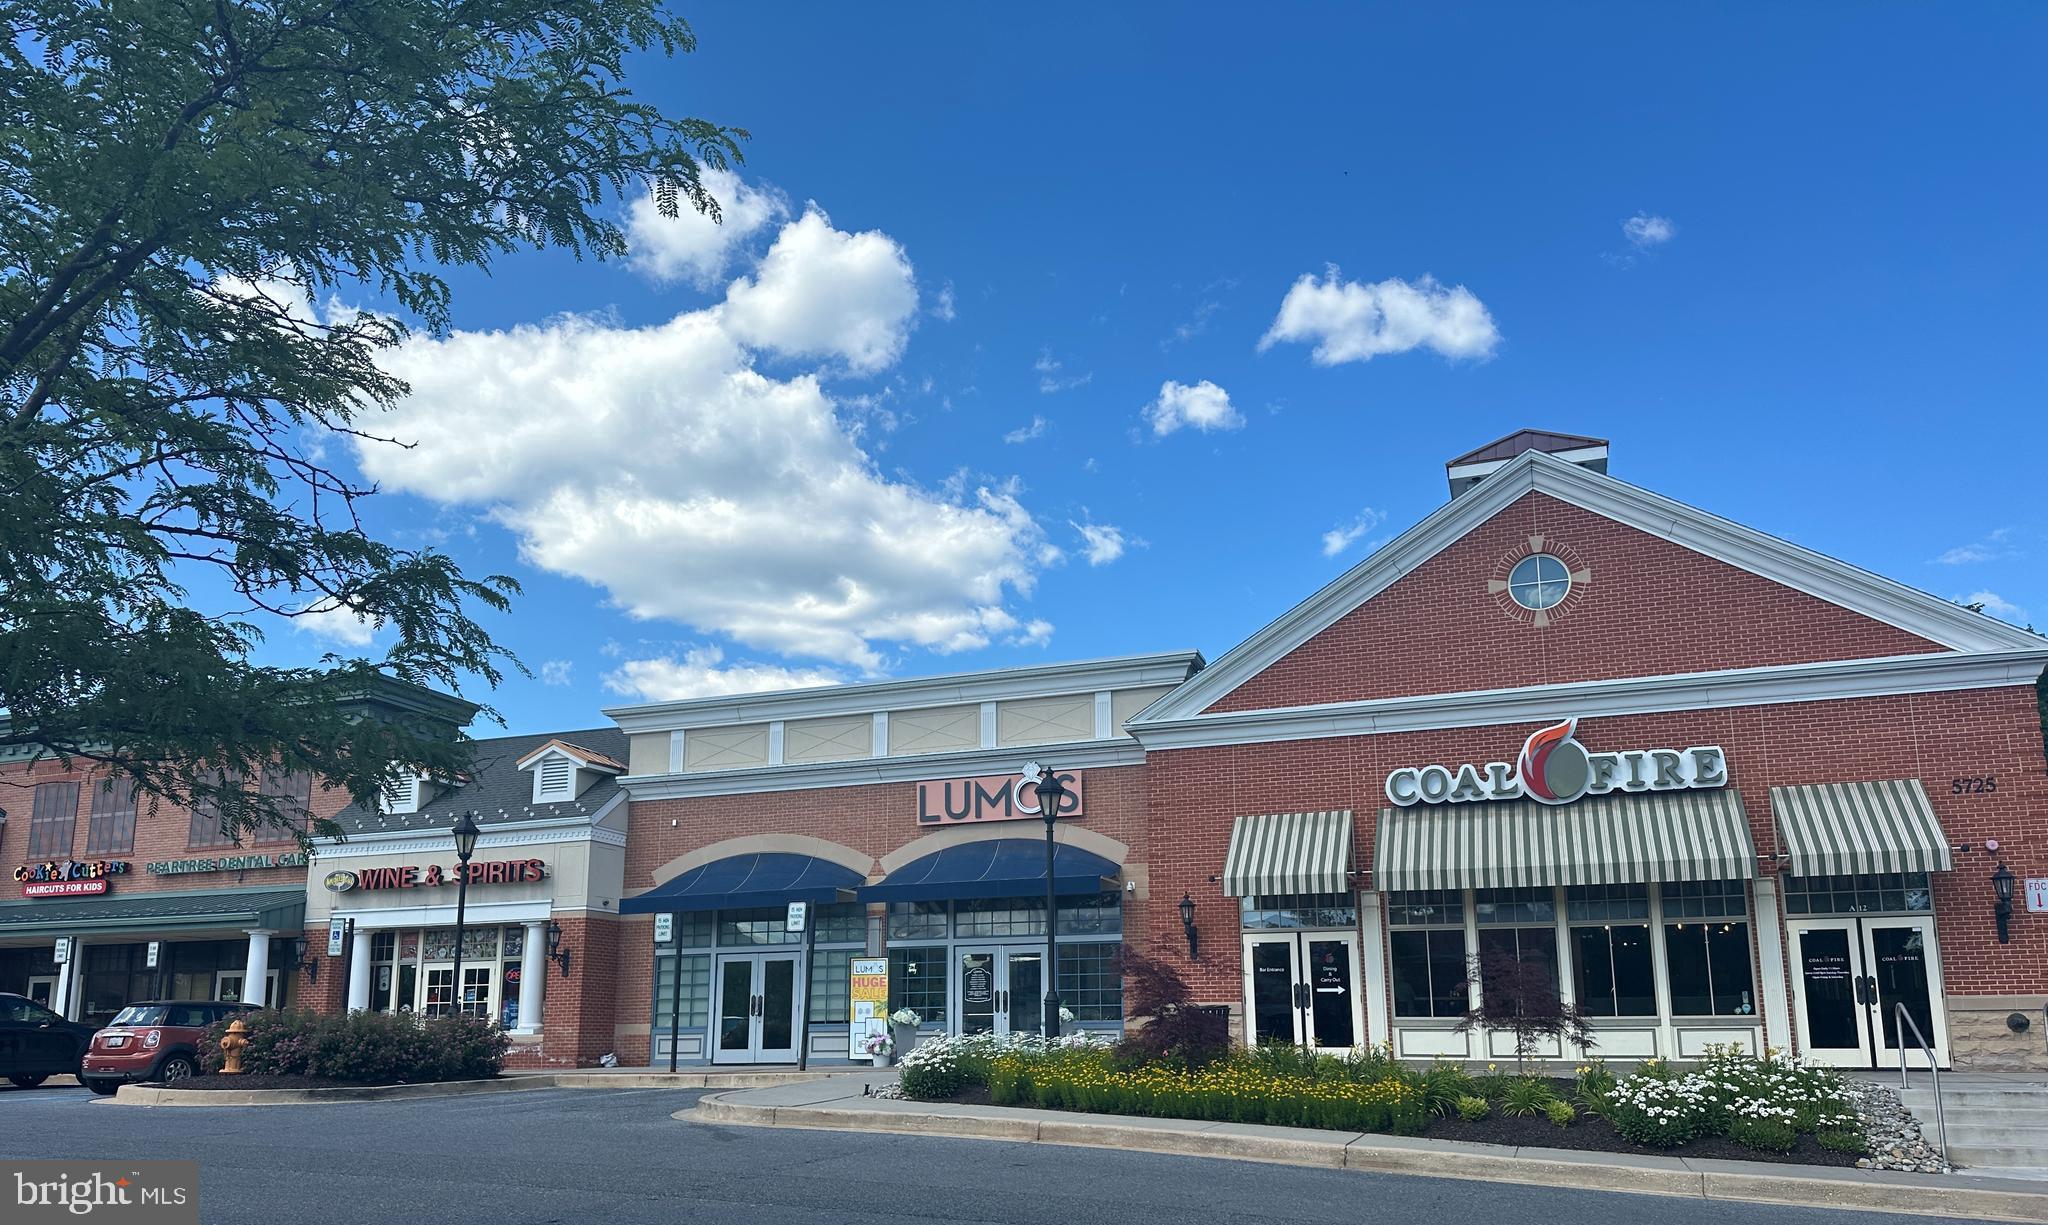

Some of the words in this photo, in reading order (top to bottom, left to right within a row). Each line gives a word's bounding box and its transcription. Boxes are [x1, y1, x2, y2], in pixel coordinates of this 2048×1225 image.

[1389, 765, 1519, 800] COAL
[1589, 750, 1724, 789] FIRE
[1952, 777, 1996, 794] 5725
[919, 772, 1079, 822] LUMOS
[72, 860, 125, 879] Cutters
[146, 858, 214, 874] PEARTREE
[217, 856, 272, 870] DENTAL
[278, 852, 308, 866] CAR
[359, 866, 415, 889] WINE
[425, 865, 441, 887] &
[452, 859, 543, 885] SPIRITS
[26, 884, 65, 894] HAIRCUTS
[66, 883, 81, 892] FOR
[83, 882, 103, 891] KIDS
[2028, 882, 2047, 891] FDC
[852, 976, 887, 987] HUGE
[852, 988, 887, 1000] SALE
